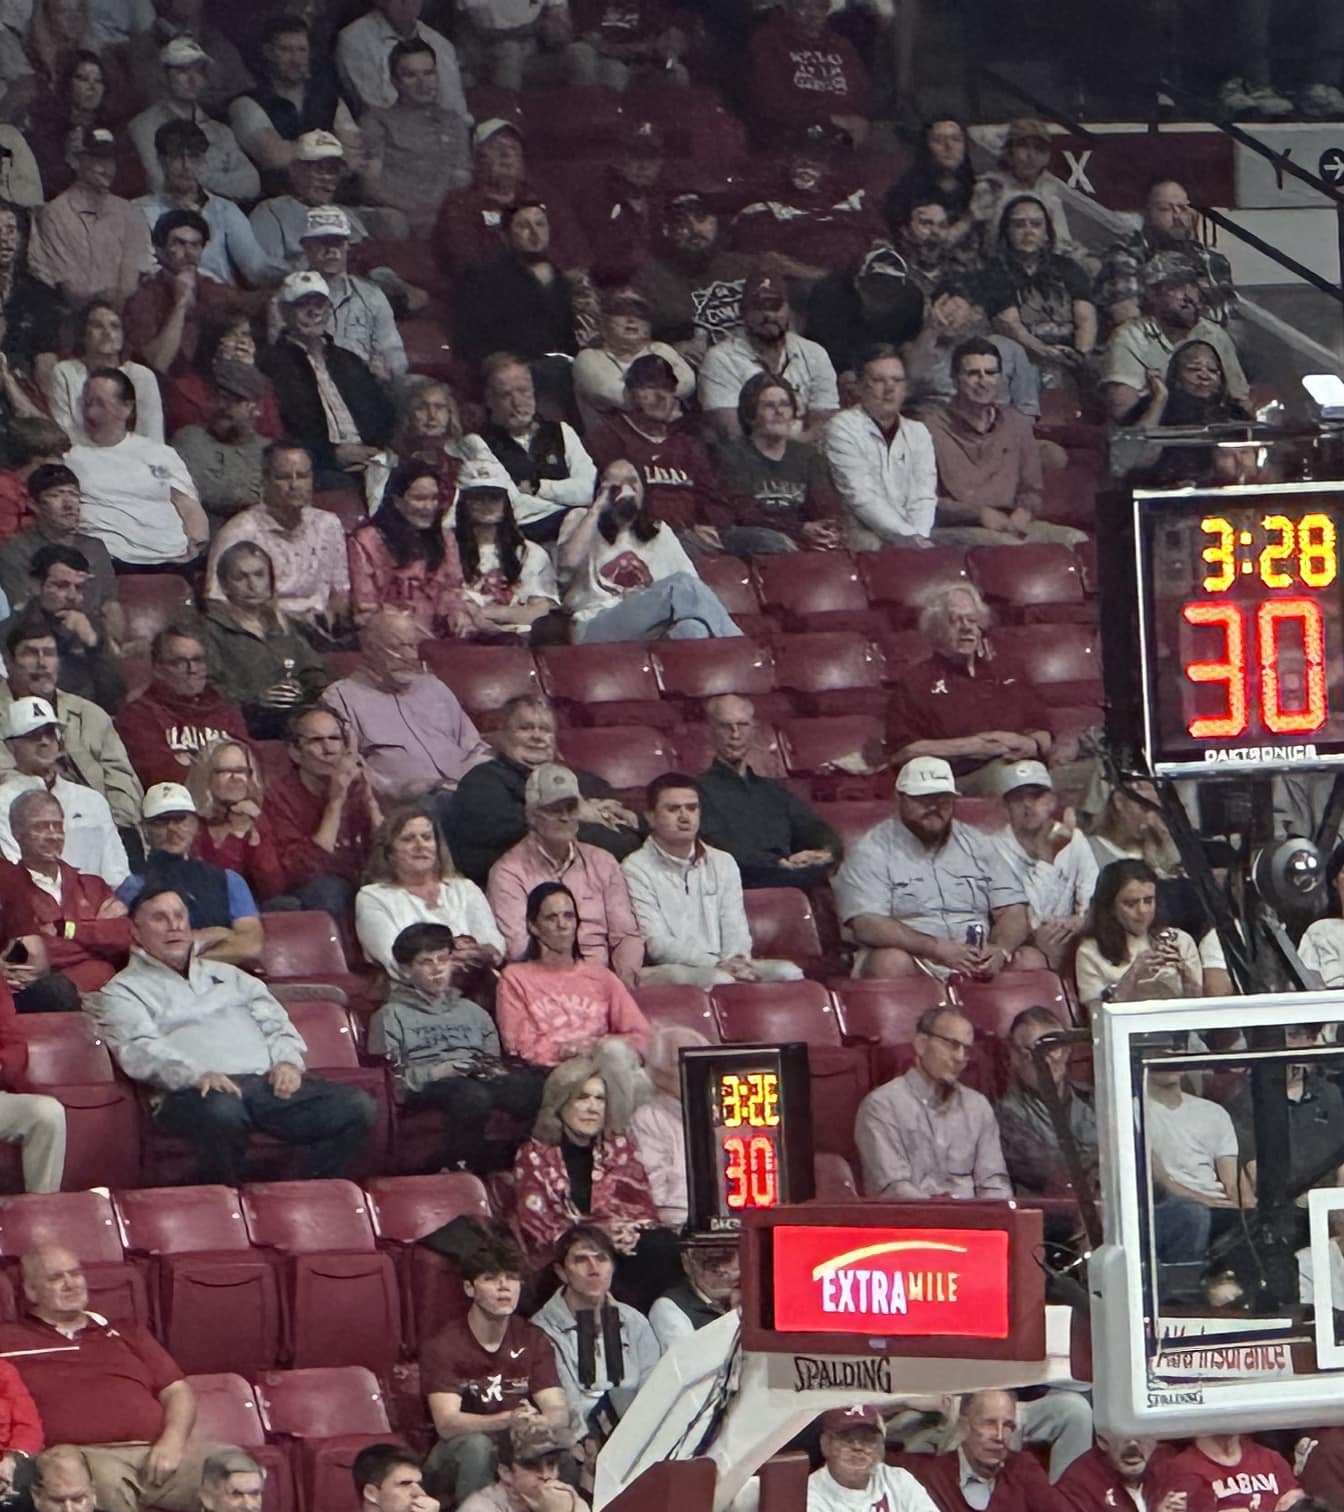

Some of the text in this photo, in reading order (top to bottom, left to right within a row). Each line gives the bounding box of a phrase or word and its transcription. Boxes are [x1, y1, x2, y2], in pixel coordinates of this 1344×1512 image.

[1201, 512, 1338, 593] 3:28
[1183, 596, 1328, 740] 30
[1203, 746, 1318, 764] DAKTRONICS
[793, 1354, 891, 1393] SPALDING
